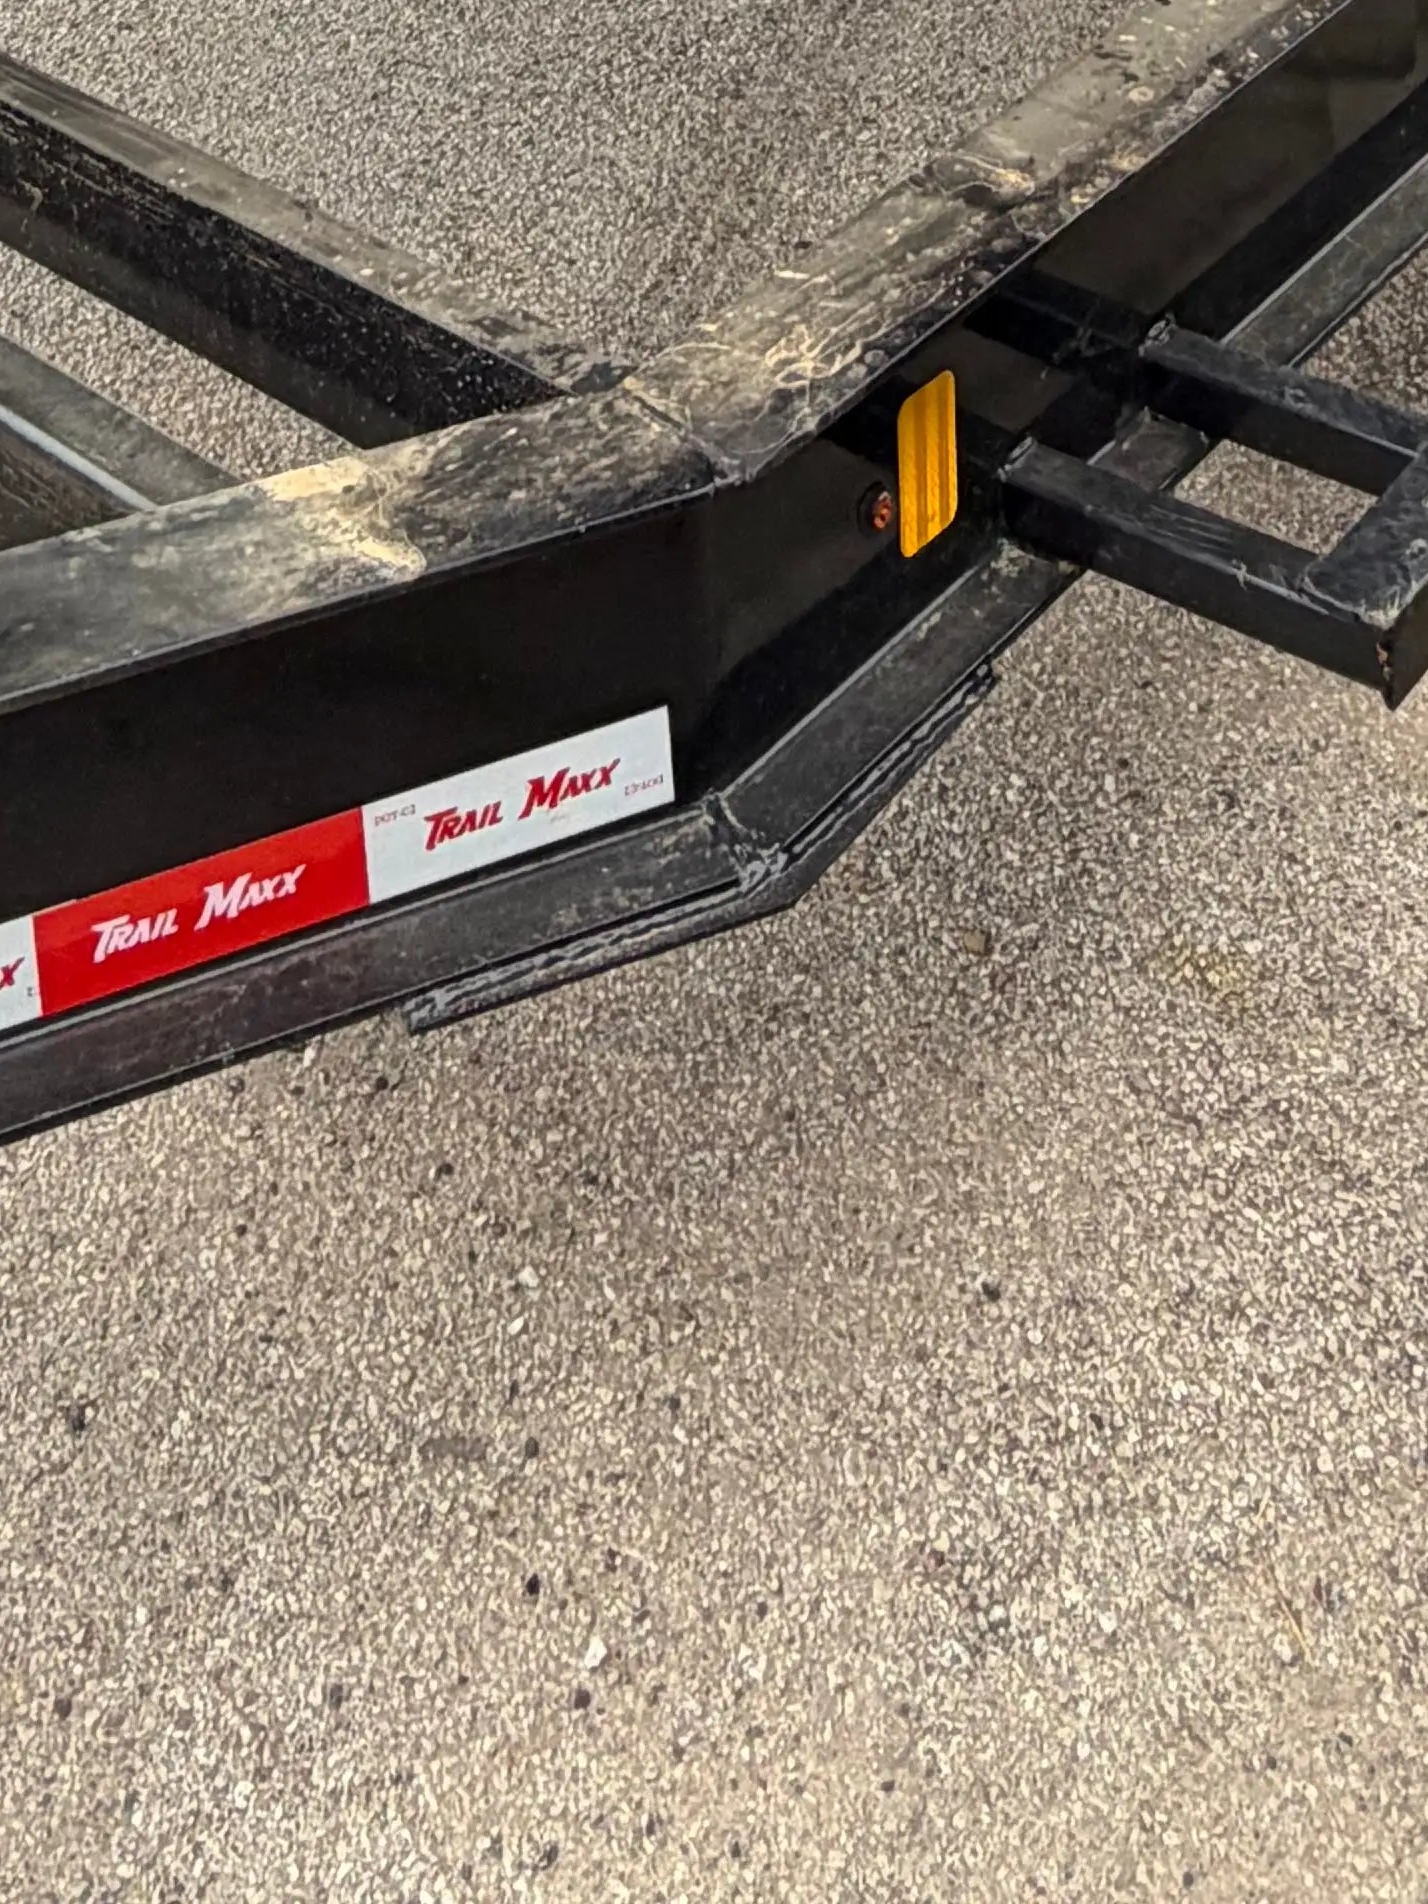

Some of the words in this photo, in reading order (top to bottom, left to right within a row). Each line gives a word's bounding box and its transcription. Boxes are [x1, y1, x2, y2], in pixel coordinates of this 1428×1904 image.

[423, 800, 504, 851] TRAIL
[518, 757, 621, 821] MAXX
[91, 908, 179, 964] TRAIL
[193, 863, 307, 932] MAXX
